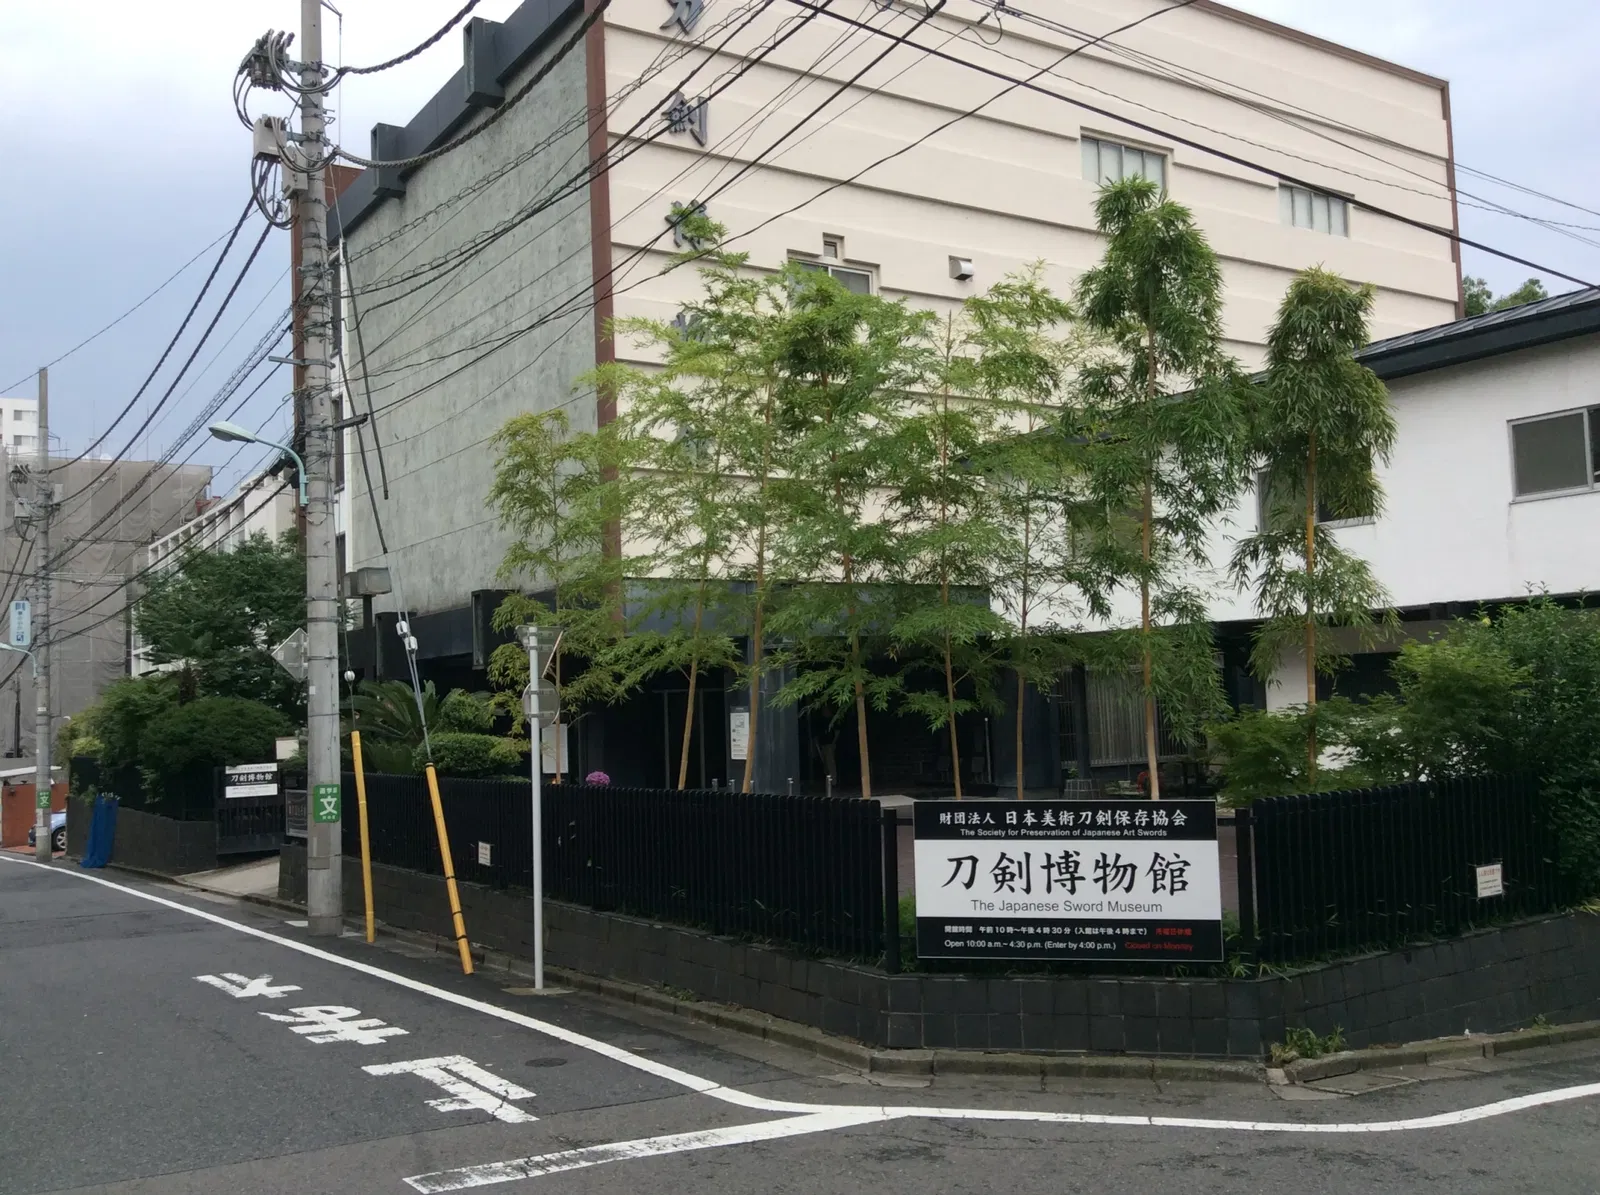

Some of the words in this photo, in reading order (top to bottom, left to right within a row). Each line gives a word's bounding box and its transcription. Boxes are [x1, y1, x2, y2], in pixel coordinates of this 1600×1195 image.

[939, 811, 996, 825] 財団法人
[1005, 809, 1188, 827] 日本美術刀剣保存協会
[977, 829, 1006, 837] Society
[1021, 829, 1070, 837] Preservation
[1072, 829, 1080, 837] of
[1082, 829, 1121, 837] Japanese
[1122, 829, 1135, 837] Art
[1137, 829, 1167, 837] Swords
[941, 850, 1192, 896] 刀剣博物館
[971, 900, 995, 911] The
[998, 900, 1059, 913] Japanese
[1063, 900, 1103, 912] Sword
[1107, 901, 1163, 913] Museum
[944, 940, 964, 948] Open
[1044, 941, 1067, 950] (Enter
[1068, 942, 1077, 950] by
[1096, 942, 1116, 950] p.m.)
